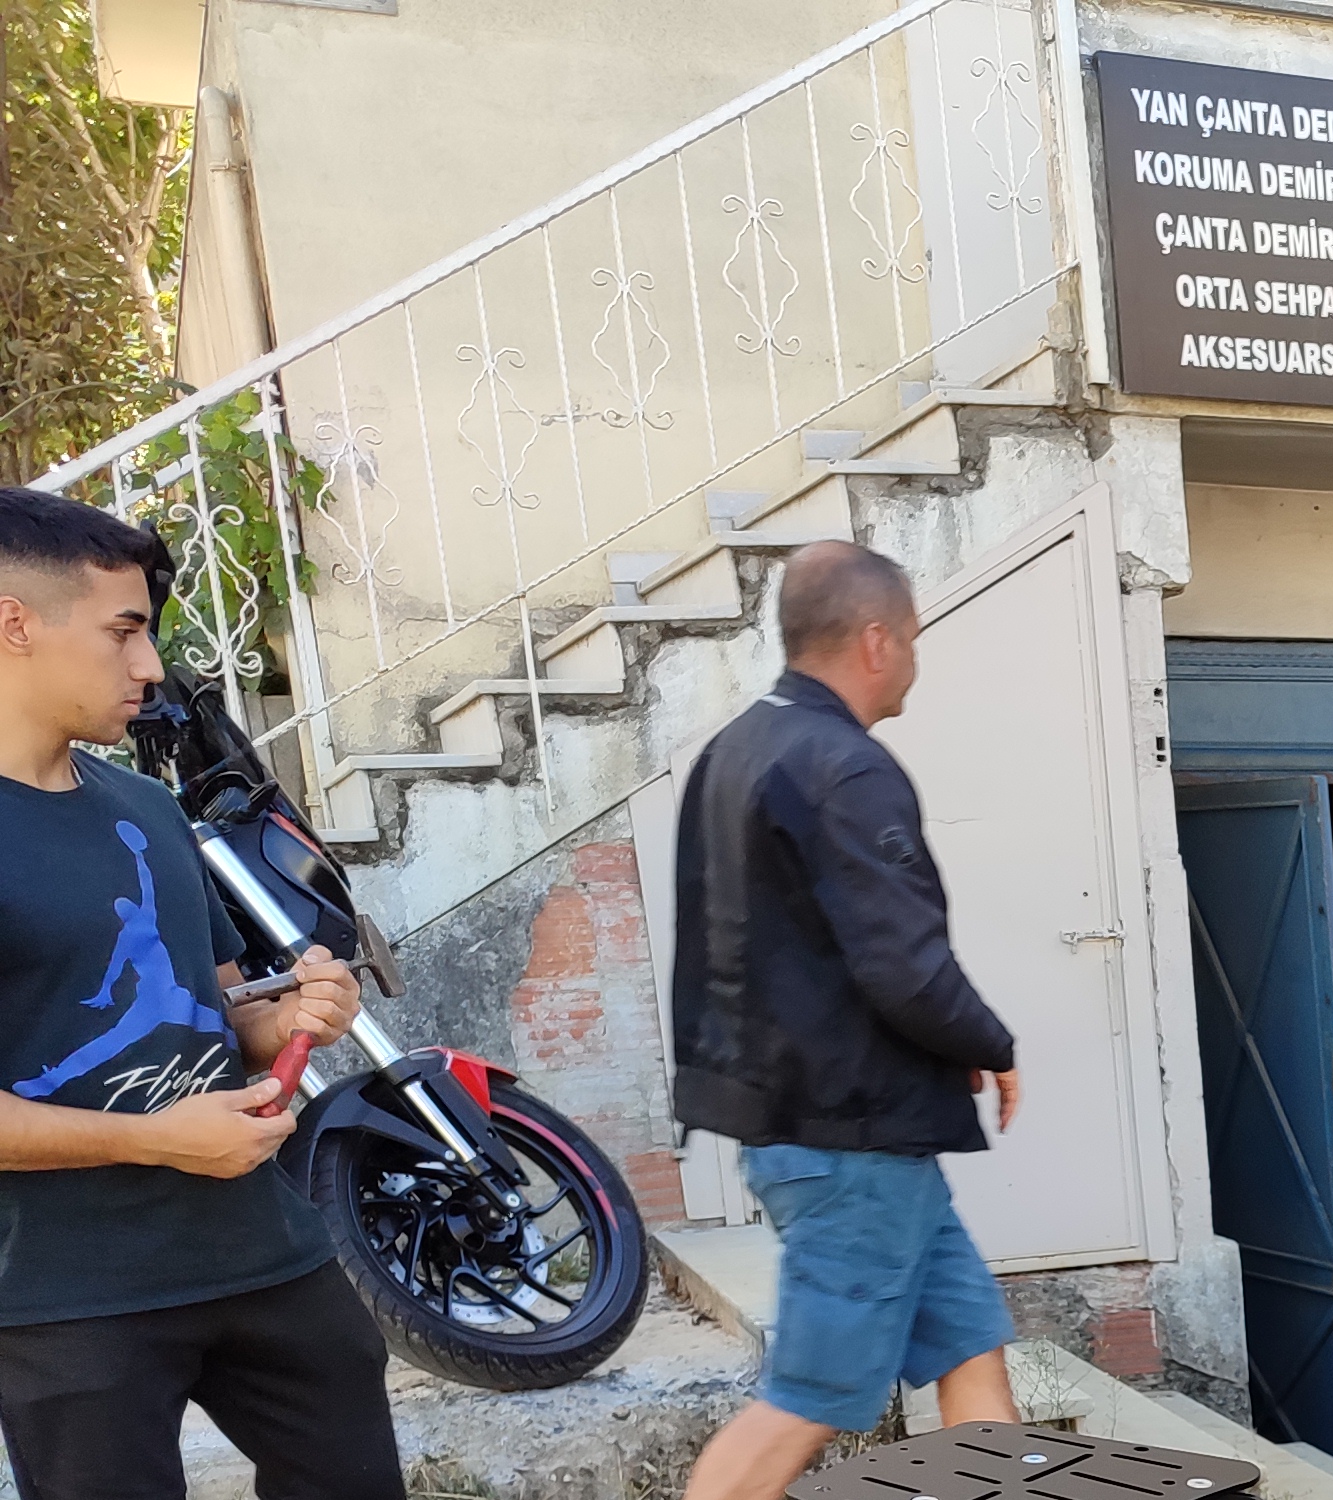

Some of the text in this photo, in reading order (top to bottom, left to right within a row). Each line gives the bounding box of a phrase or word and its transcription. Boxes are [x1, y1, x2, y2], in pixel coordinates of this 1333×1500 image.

[1130, 87, 1188, 127] YAN
[1195, 95, 1287, 138] ÇANTA
[1134, 150, 1254, 195] KORUMA
[1155, 212, 1247, 254] ÇANTA
[1175, 274, 1249, 313] ORTA
[103, 1042, 230, 1115] Flight
